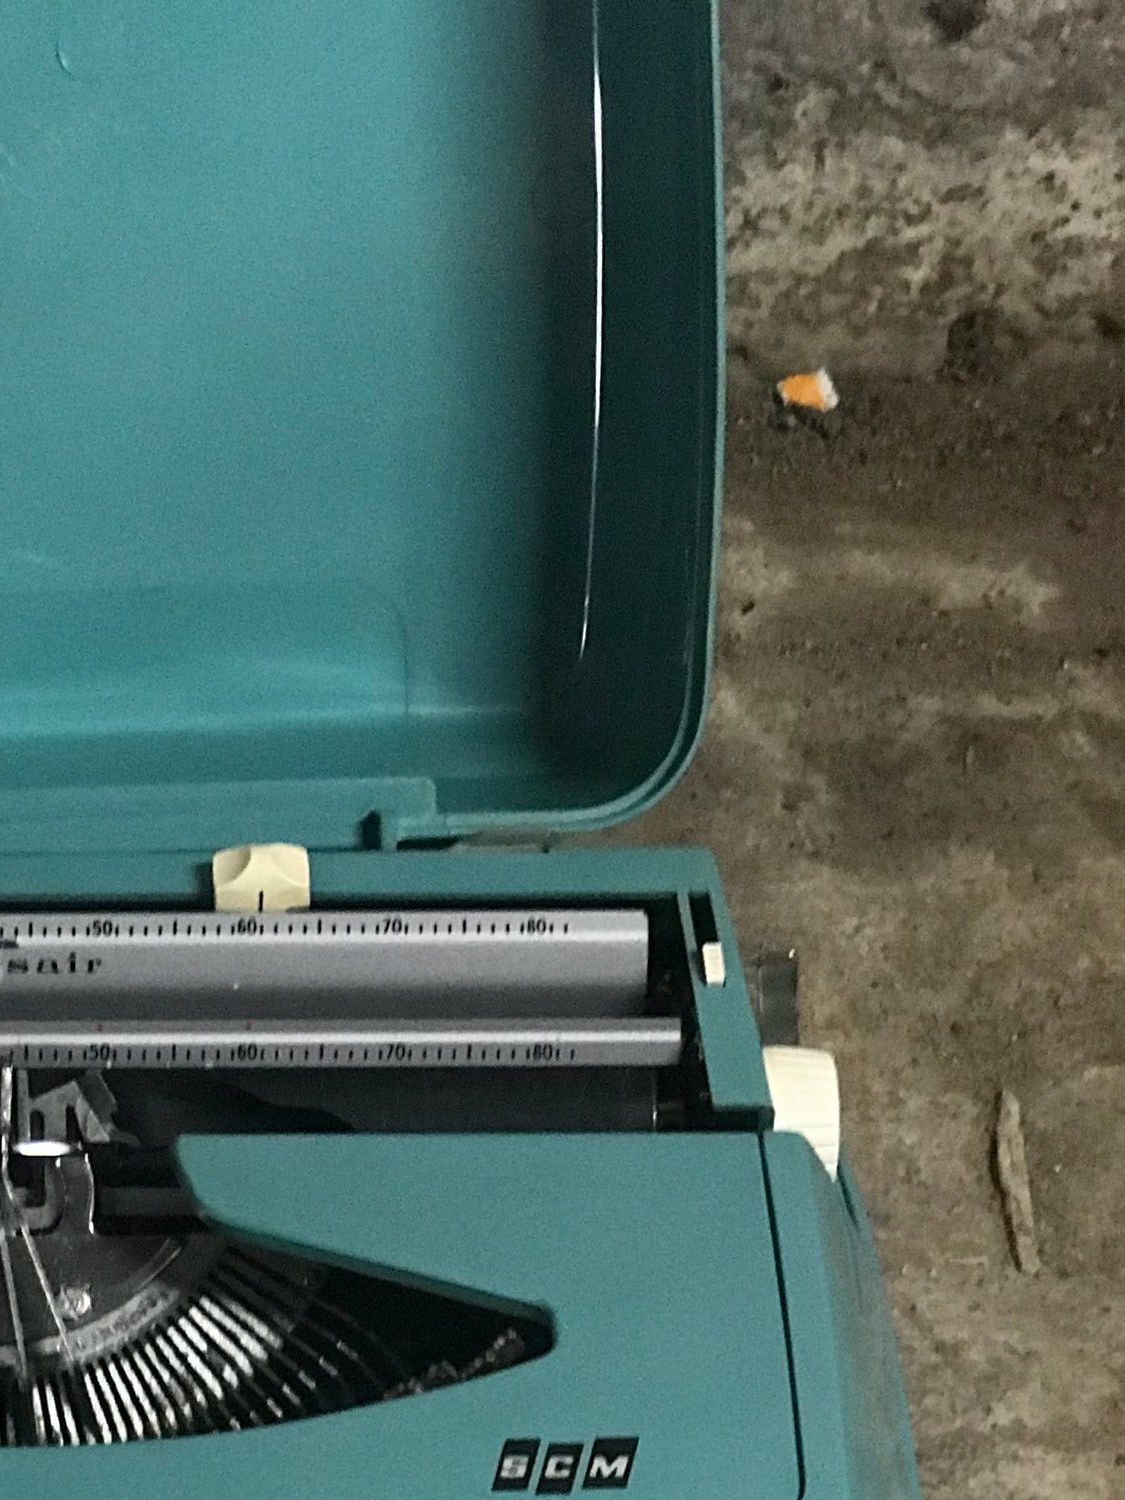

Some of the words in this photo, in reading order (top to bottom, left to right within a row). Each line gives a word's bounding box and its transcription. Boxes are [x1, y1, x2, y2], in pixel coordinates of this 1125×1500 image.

[92, 919, 113, 936] 50
[237, 917, 258, 935] 60
[383, 918, 403, 935] 70
[527, 917, 547, 934] 80
[90, 1044, 111, 1062] 50
[238, 1044, 258, 1061] 60
[385, 1044, 406, 1061] 70
[532, 1044, 554, 1061] 80
[500, 1455, 629, 1480] SCM
